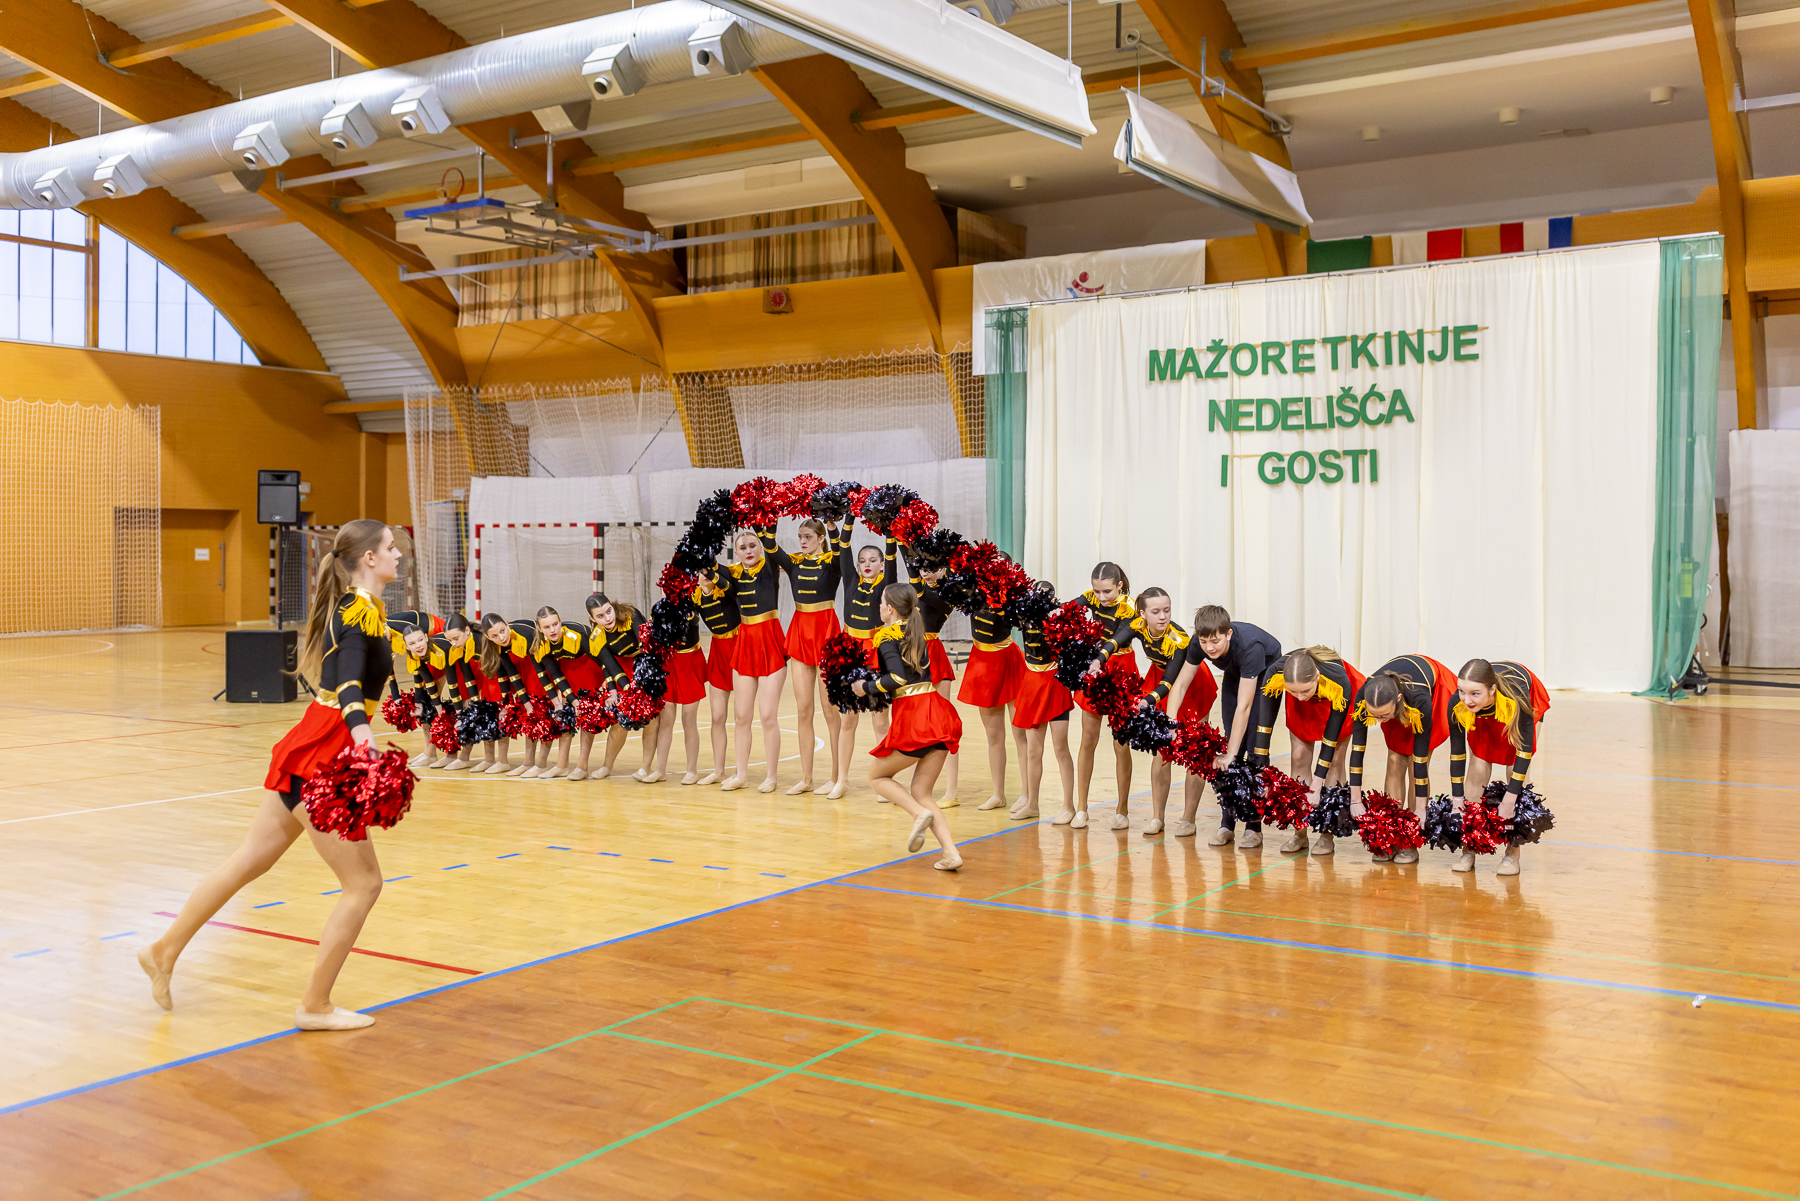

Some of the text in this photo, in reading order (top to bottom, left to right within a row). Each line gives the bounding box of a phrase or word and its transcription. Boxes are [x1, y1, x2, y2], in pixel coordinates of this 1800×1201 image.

[1149, 324, 1480, 382] MAŽORETKINJE
[1208, 383, 1416, 432] NEDELIŠĆA
[1220, 448, 1379, 487] I GOSTI
